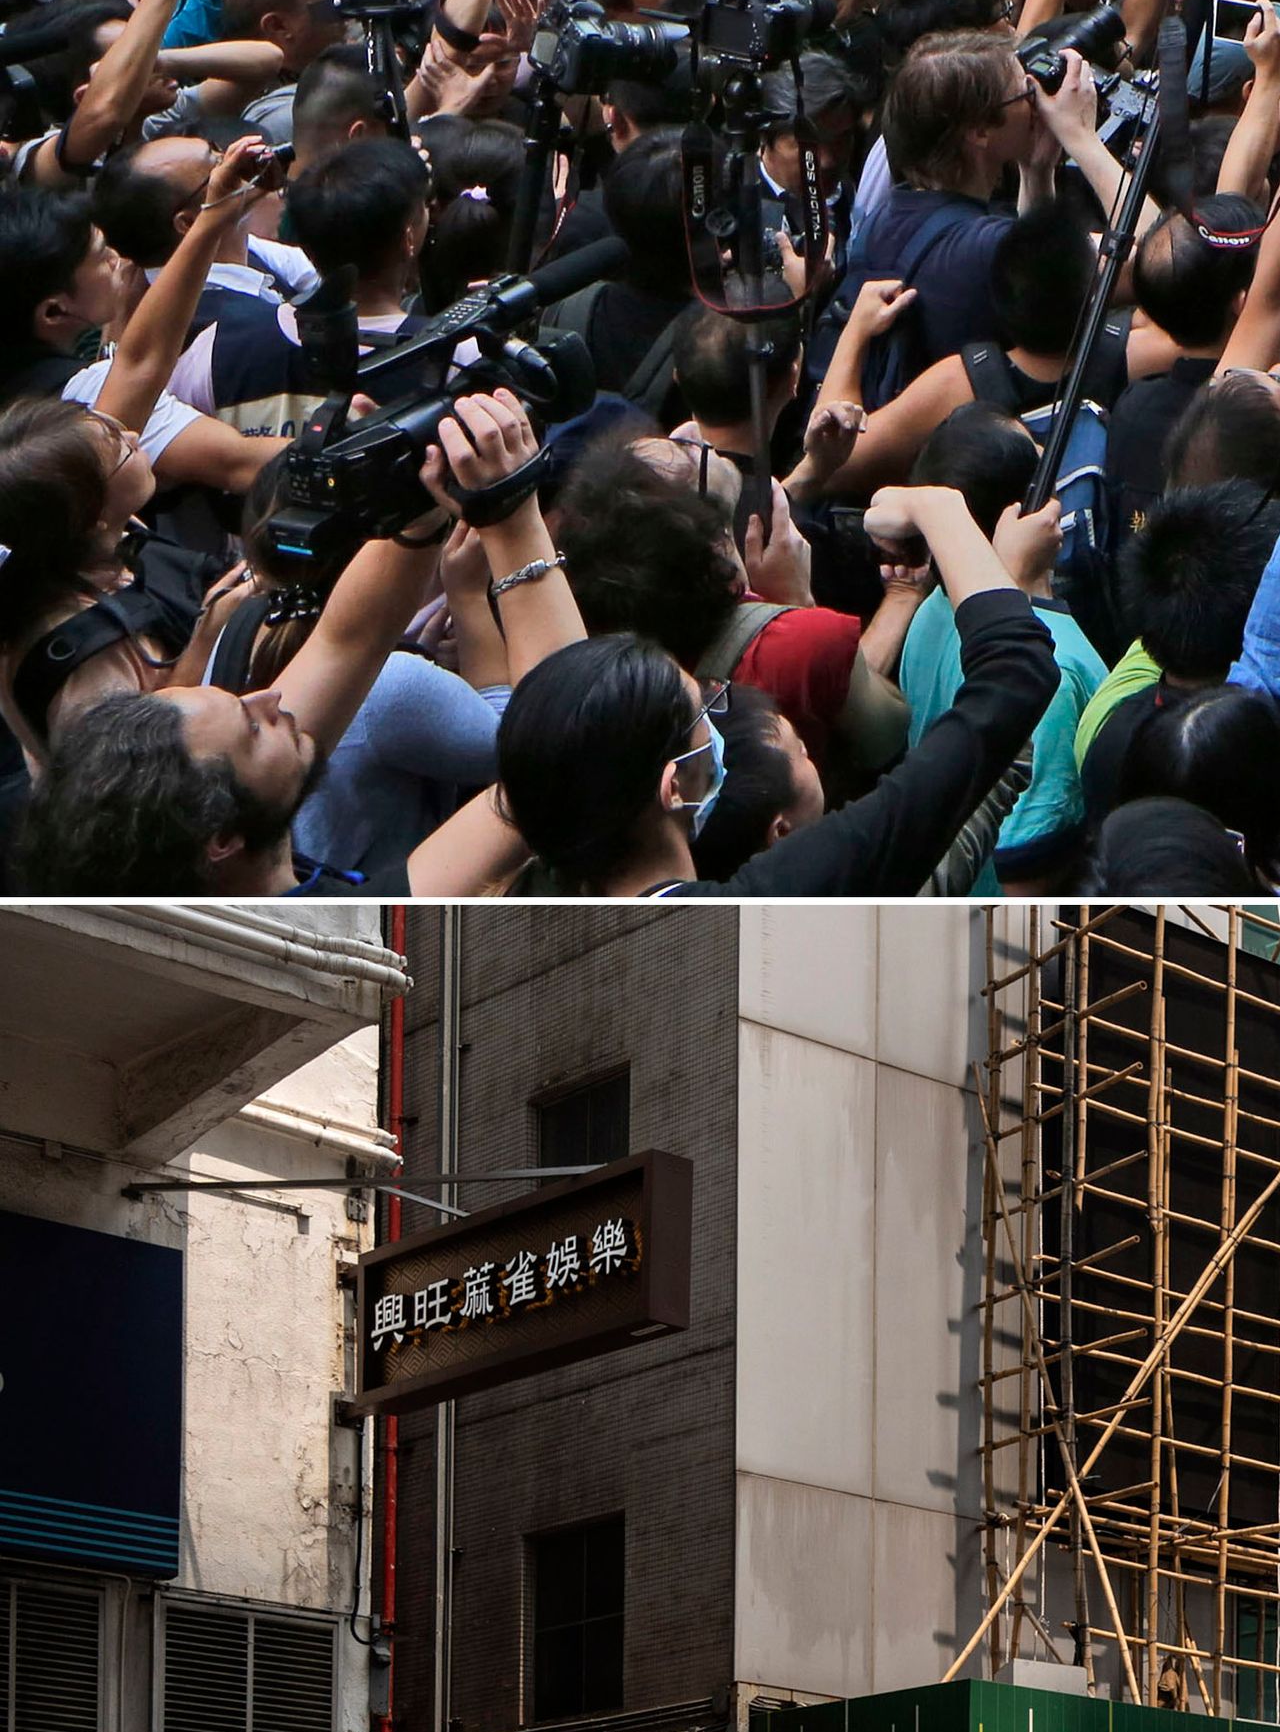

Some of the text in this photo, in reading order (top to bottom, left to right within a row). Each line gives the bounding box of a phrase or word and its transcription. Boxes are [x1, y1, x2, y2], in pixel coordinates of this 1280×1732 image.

[691, 164, 706, 218] Canon
[805, 151, 821, 241] EOS DIGITAL
[1198, 224, 1252, 246] Canon
